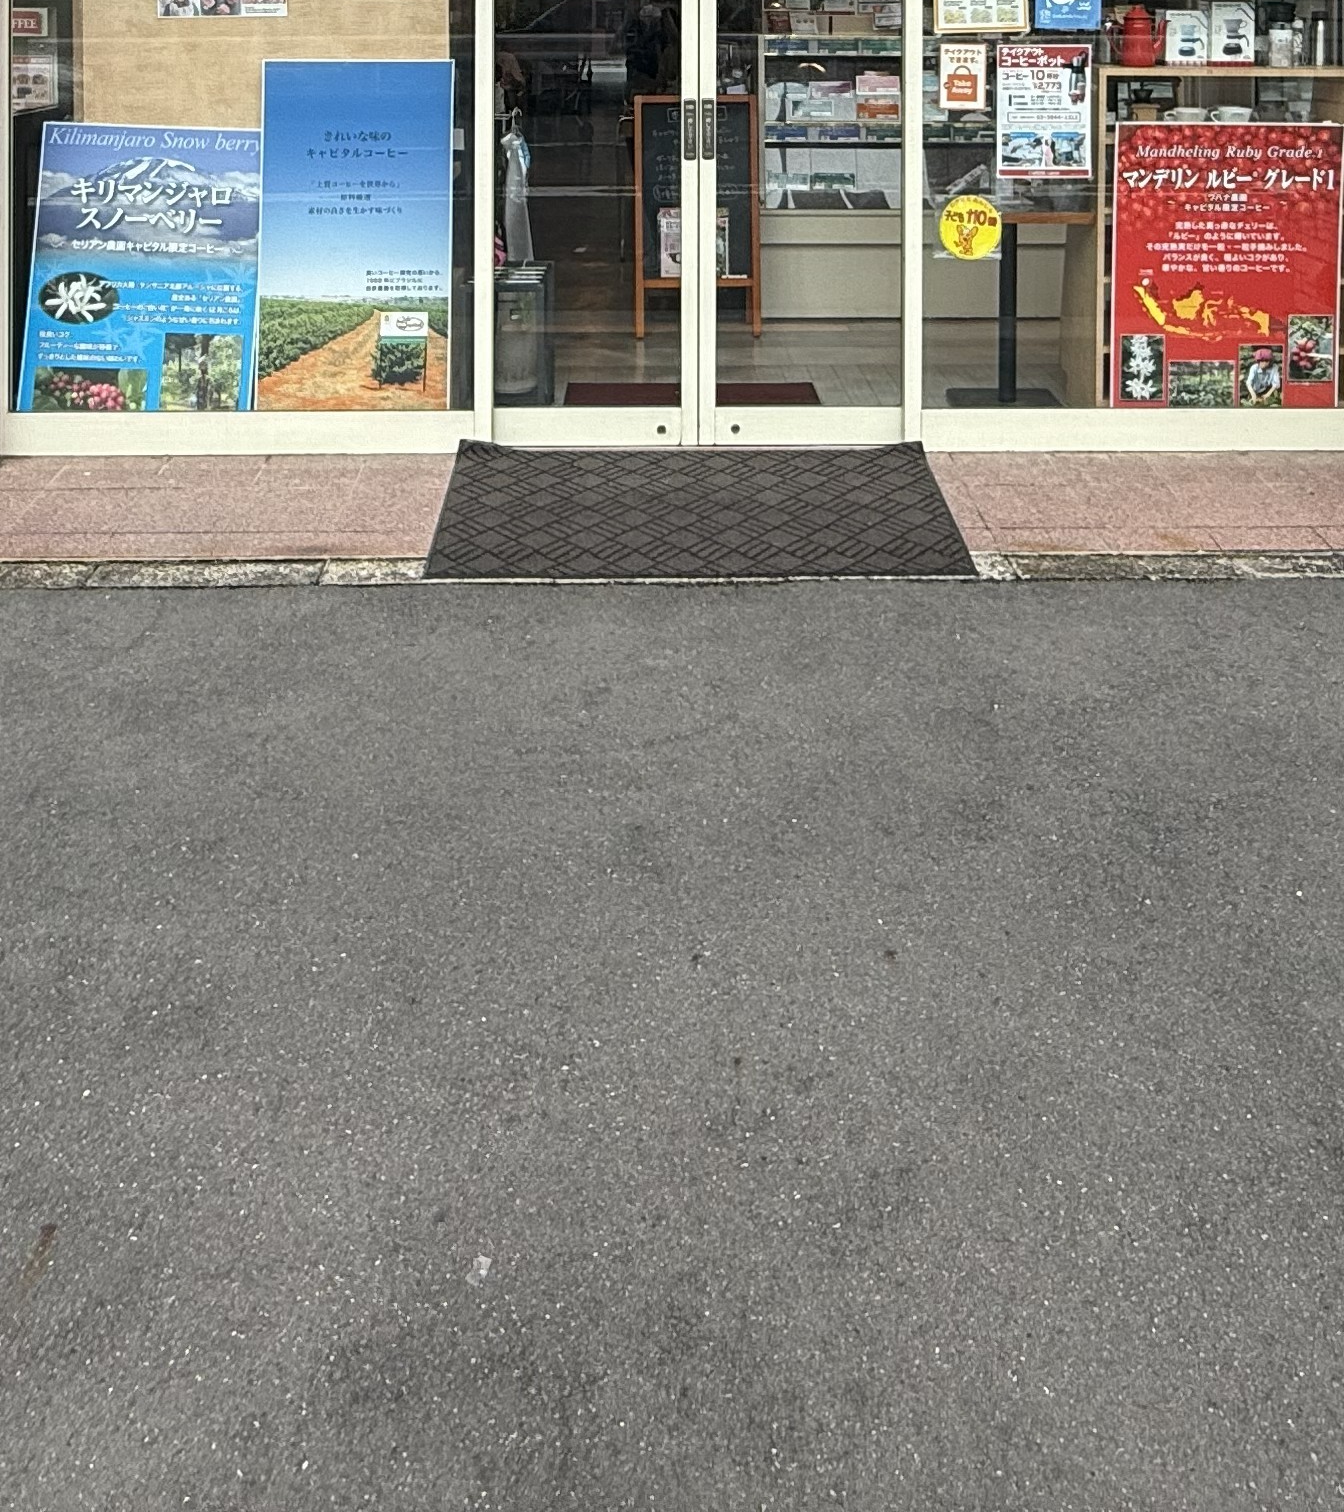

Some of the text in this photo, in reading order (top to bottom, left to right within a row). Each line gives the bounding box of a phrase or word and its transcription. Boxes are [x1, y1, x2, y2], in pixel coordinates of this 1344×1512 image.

[12, 18, 39, 29] FFEE
[1001, 47, 1045, 57] テイクアウト
[1001, 55, 1066, 67] コーヒーポット
[48, 127, 261, 157] Kilimanjaro Snow berry
[306, 148, 409, 159] キャピタルコーヒー
[1136, 145, 1221, 160] Mandheling
[1225, 145, 1263, 161] Ruby
[1122, 167, 1199, 190] マンデリン
[1206, 166, 1253, 190] ルビー
[70, 177, 234, 208] キリマンジャロ
[75, 206, 223, 234] スノーベリー
